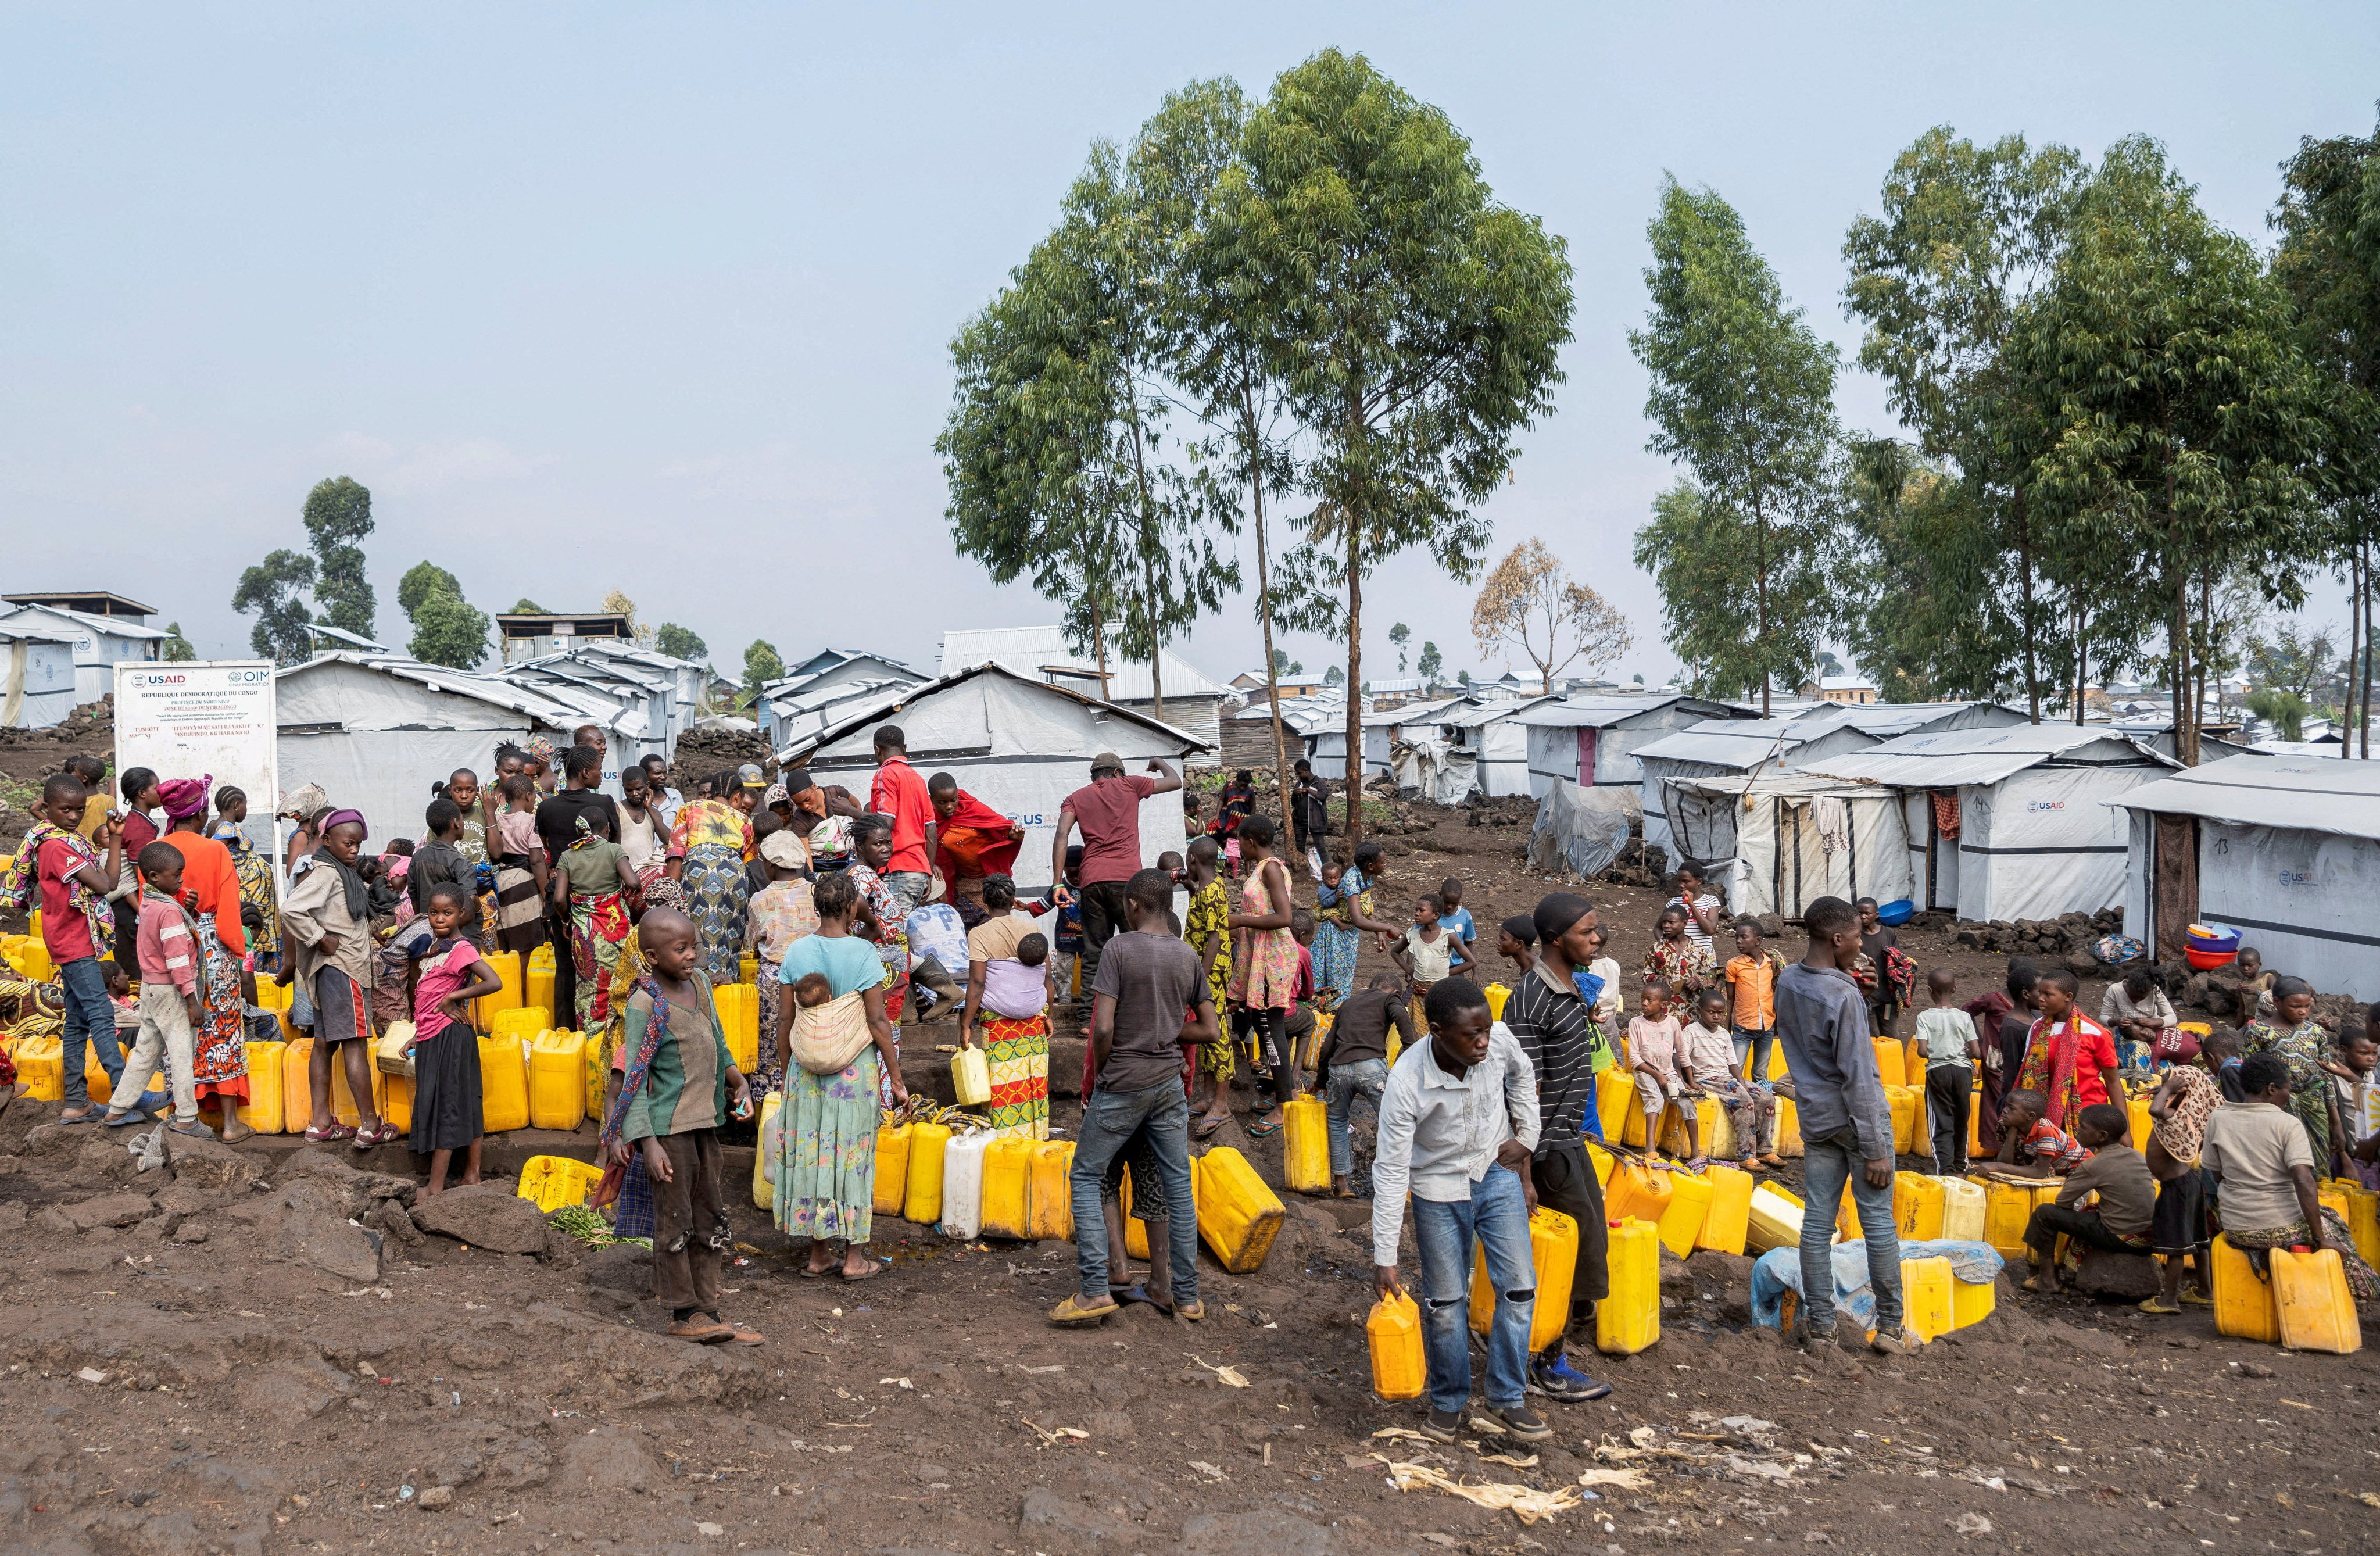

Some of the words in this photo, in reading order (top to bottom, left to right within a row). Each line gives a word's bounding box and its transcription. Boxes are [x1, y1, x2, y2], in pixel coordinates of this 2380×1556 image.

[149, 675, 185, 684] USAID
[244, 671, 269, 681] OIM
[1973, 795, 1984, 810] 14
[2214, 838, 2229, 854] 13
